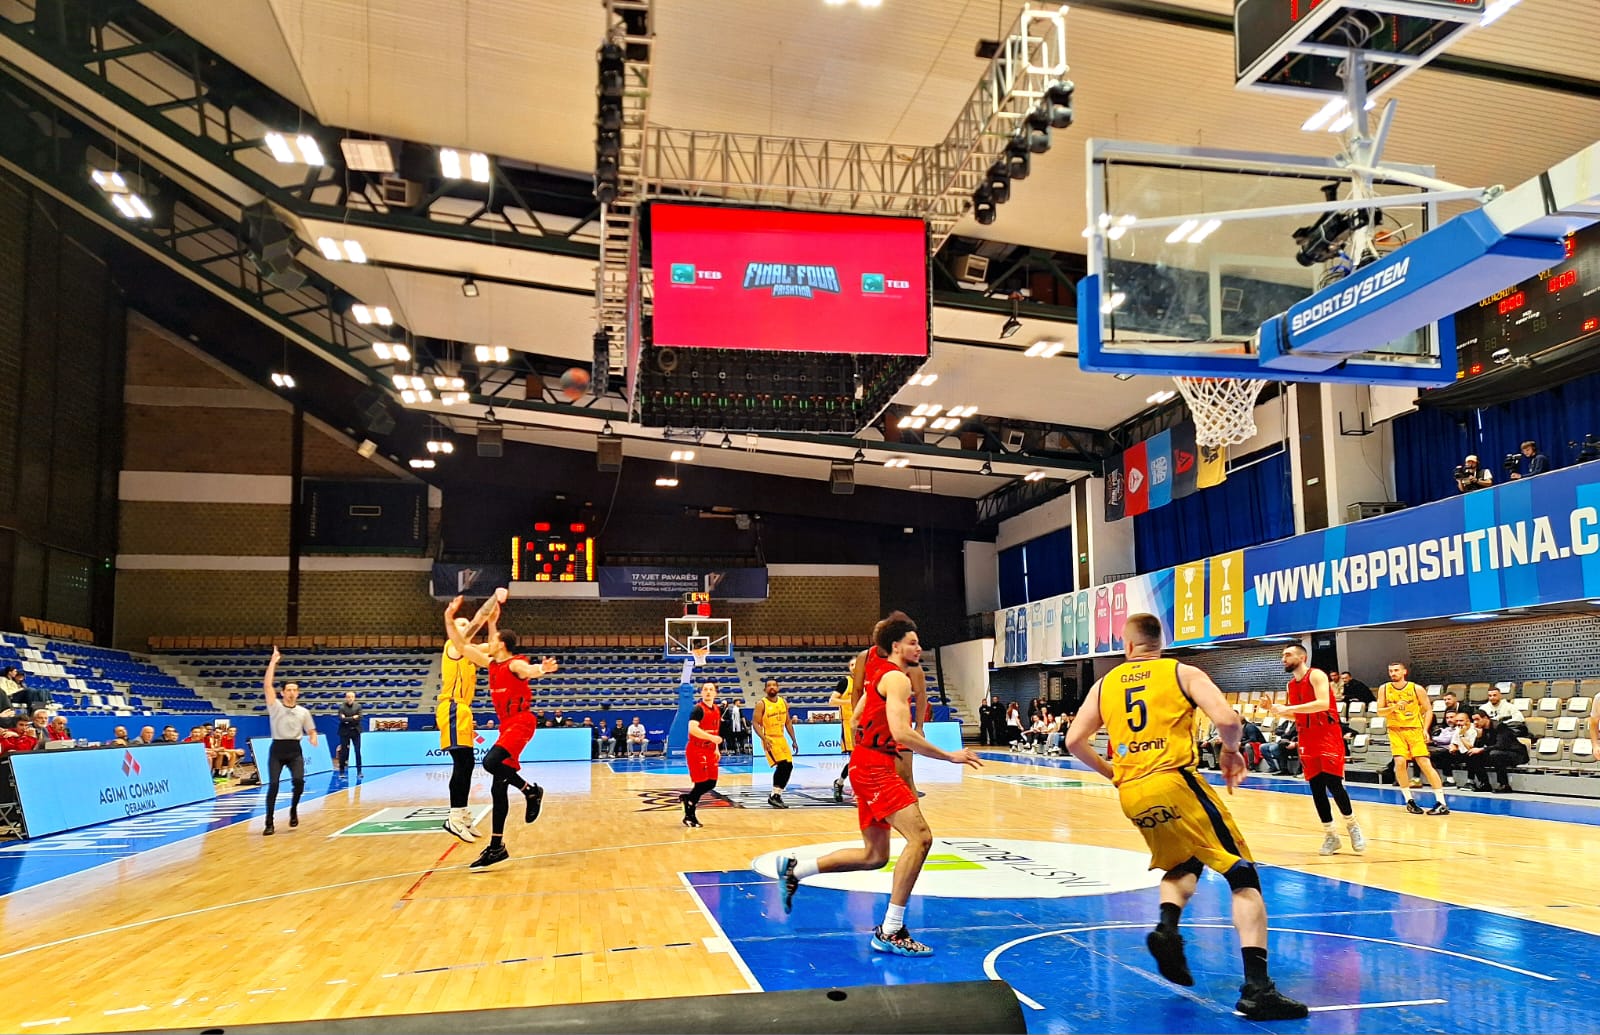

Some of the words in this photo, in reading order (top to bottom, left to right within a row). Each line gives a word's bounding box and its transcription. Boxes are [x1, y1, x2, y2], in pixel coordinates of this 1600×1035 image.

[696, 270, 722, 280] TEB
[744, 263, 791, 288] FINAL
[797, 265, 840, 292] FOUR
[885, 279, 910, 289] TEB
[1292, 257, 1410, 332] SPORTSYSTEM
[1184, 603, 1194, 622] 14
[1221, 594, 1232, 615] 15
[1120, 671, 1151, 683] GASHI
[1124, 685, 1148, 733] 5
[1128, 737, 1165, 754] Granit
[99, 786, 128, 806] AGIMI
[129, 779, 170, 799] COMPANY
